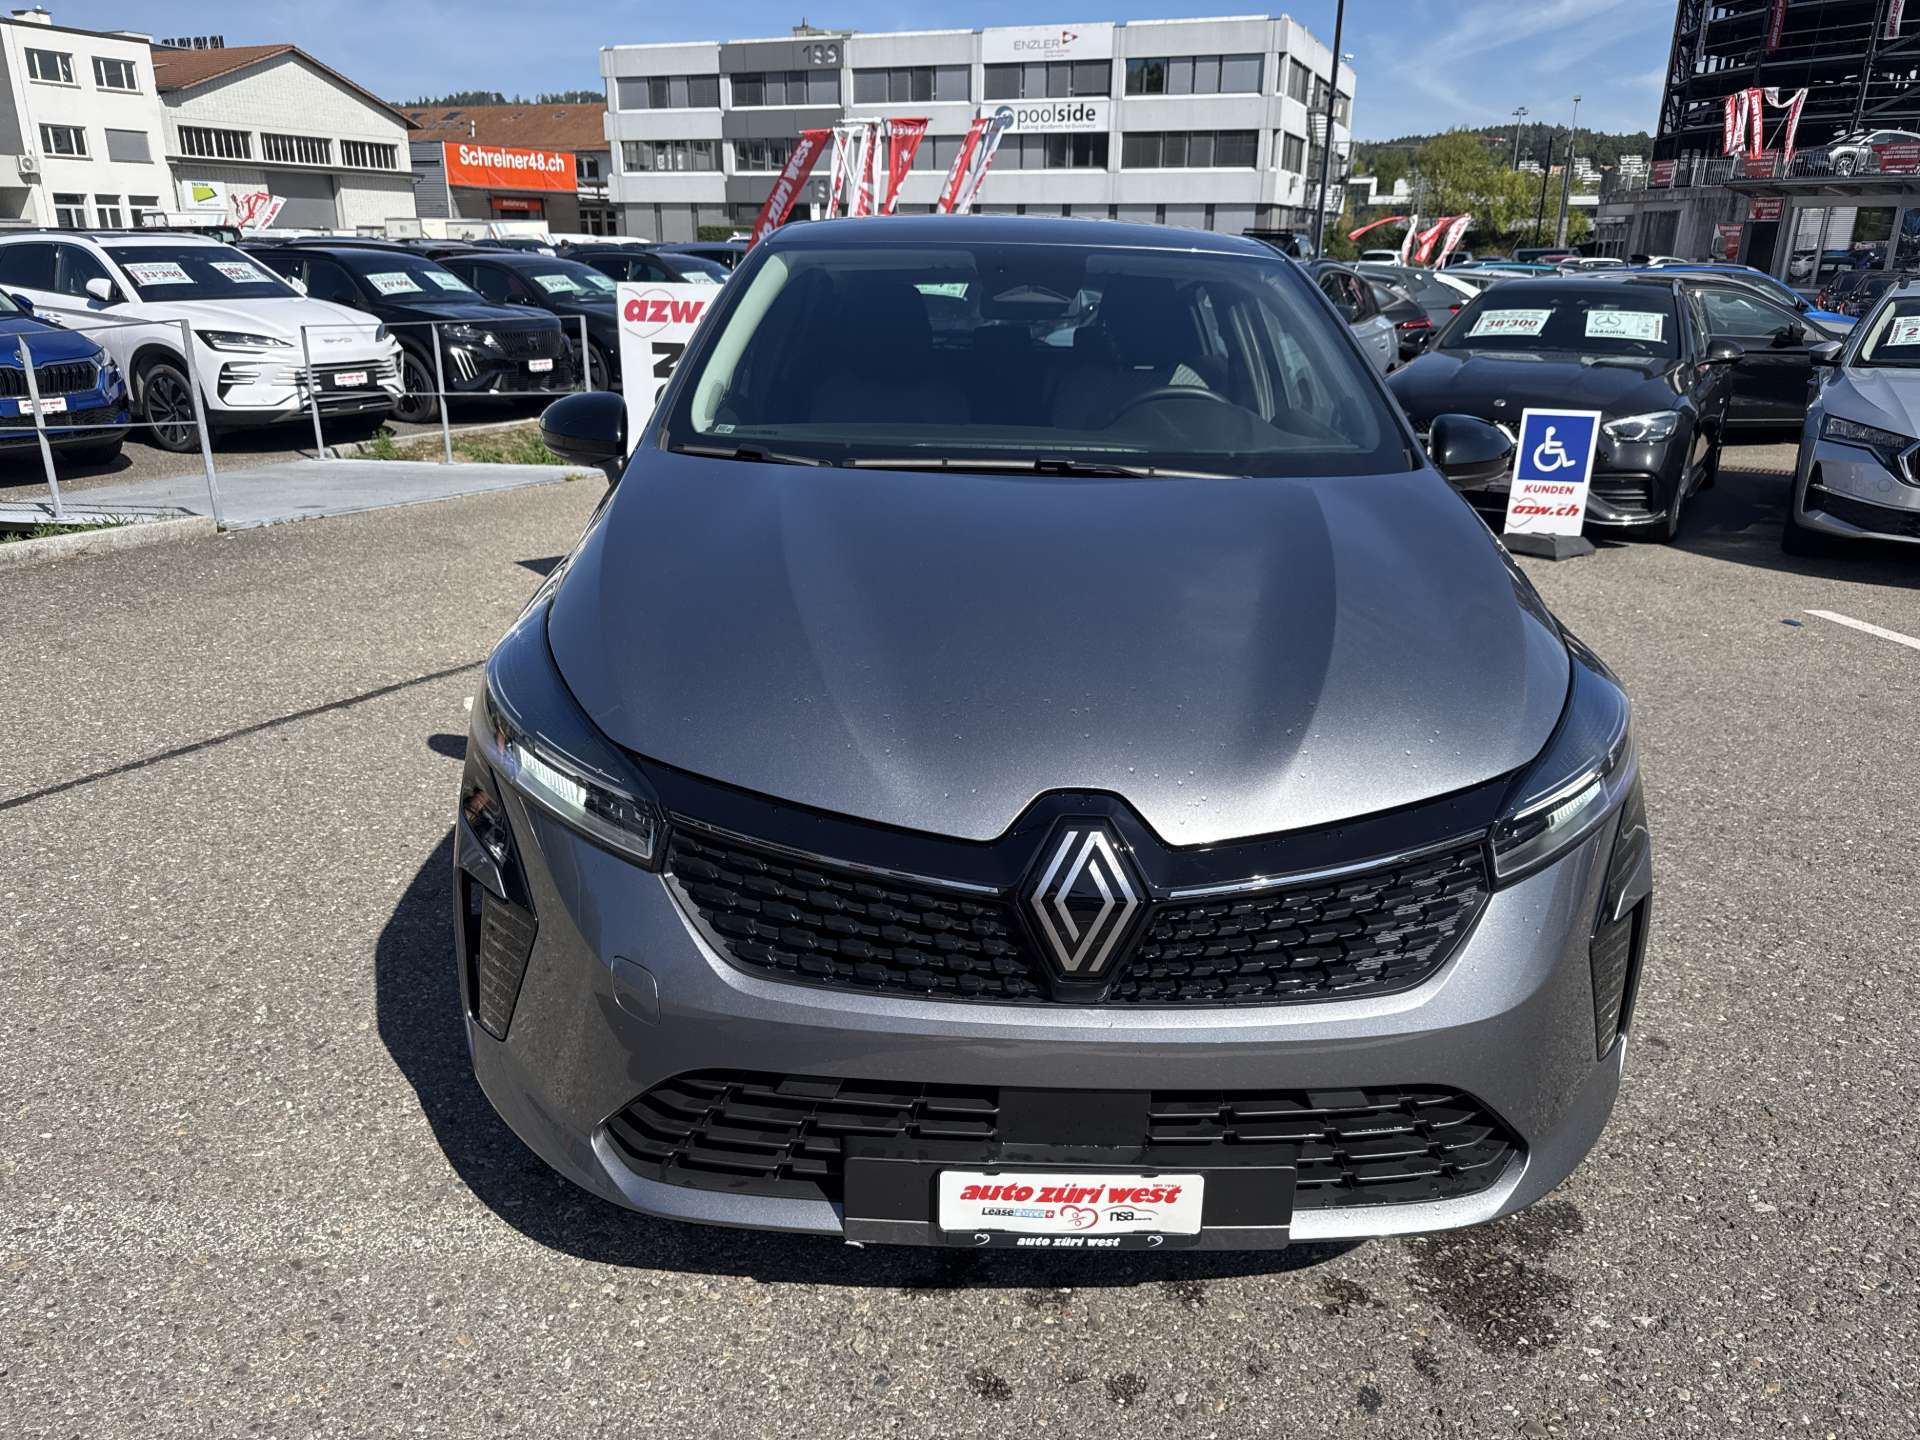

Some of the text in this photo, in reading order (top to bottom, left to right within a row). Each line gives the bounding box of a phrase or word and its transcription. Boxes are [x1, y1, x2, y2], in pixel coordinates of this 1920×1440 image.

[1013, 39, 1060, 50] ENZLER
[1017, 104, 1096, 130] poolside
[459, 144, 565, 172] Schreiner48.ch
[767, 178, 793, 225] züri
[785, 139, 814, 182] west
[1486, 319, 1538, 327] 38'300
[1524, 484, 1575, 494] KUNDEN
[1512, 505, 1580, 516] azw.ch
[959, 1183, 1182, 1204] auto züri west
[1109, 1211, 1134, 1221] nsa
[1016, 1236, 1121, 1247] auto züri west
